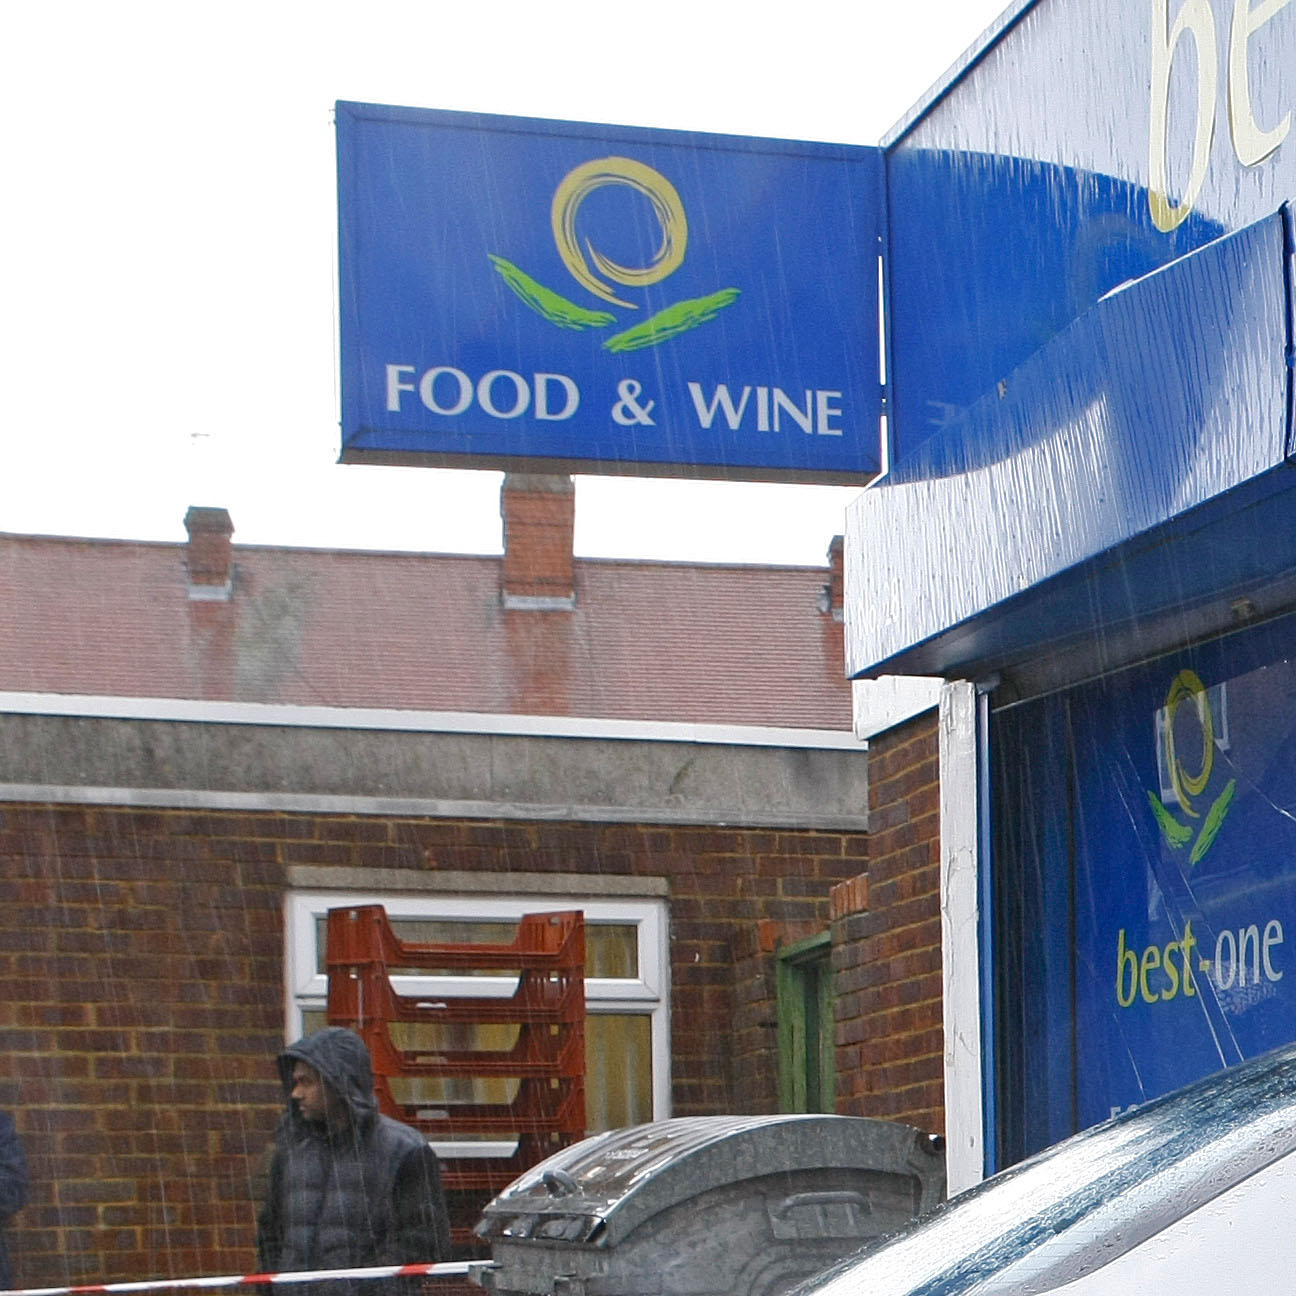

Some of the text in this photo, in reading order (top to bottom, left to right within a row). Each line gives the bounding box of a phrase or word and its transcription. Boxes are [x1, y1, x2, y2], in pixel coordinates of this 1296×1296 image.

[385, 363, 844, 436] FOOD & WINE
[1116, 919, 1284, 1008] best-one
